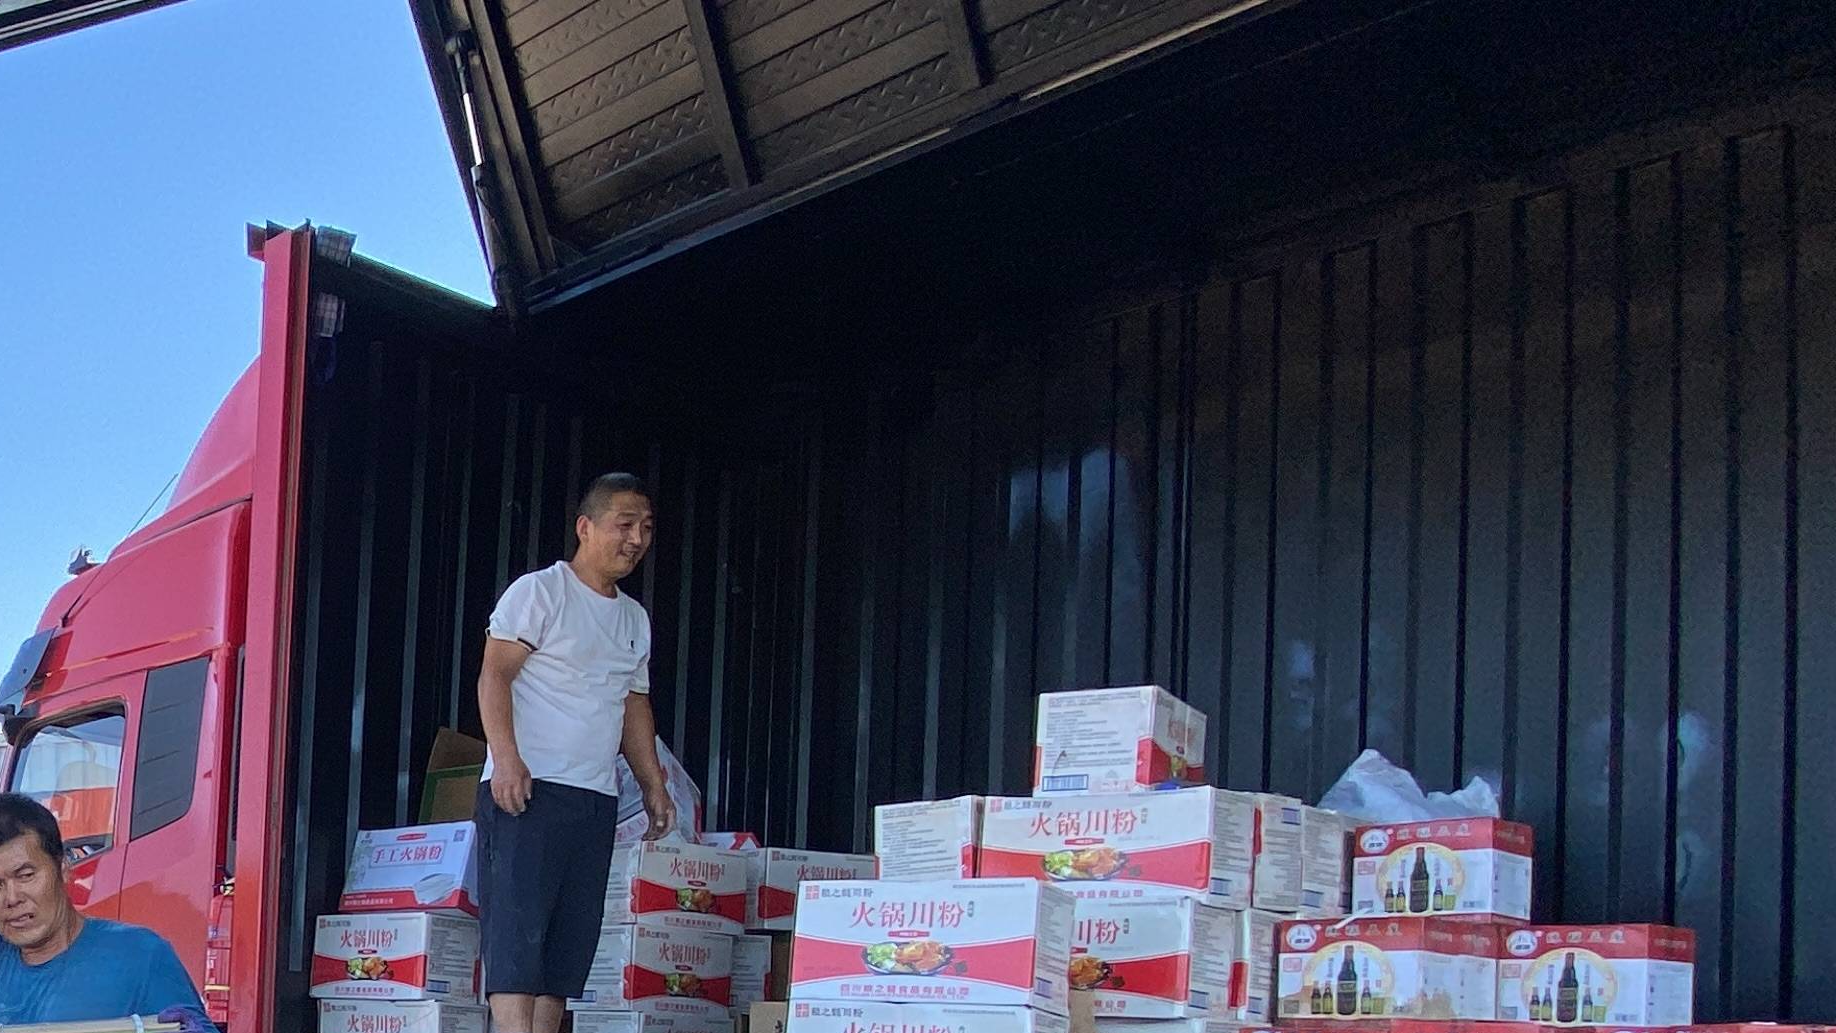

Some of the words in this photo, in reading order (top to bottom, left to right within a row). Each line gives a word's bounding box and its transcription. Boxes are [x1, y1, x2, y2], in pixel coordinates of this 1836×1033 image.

[1030, 808, 1138, 837] 火锅川粉
[670, 857, 721, 882] 火锅川粉
[849, 900, 965, 929] 火锅川粉
[340, 928, 393, 949] 火锅川粉
